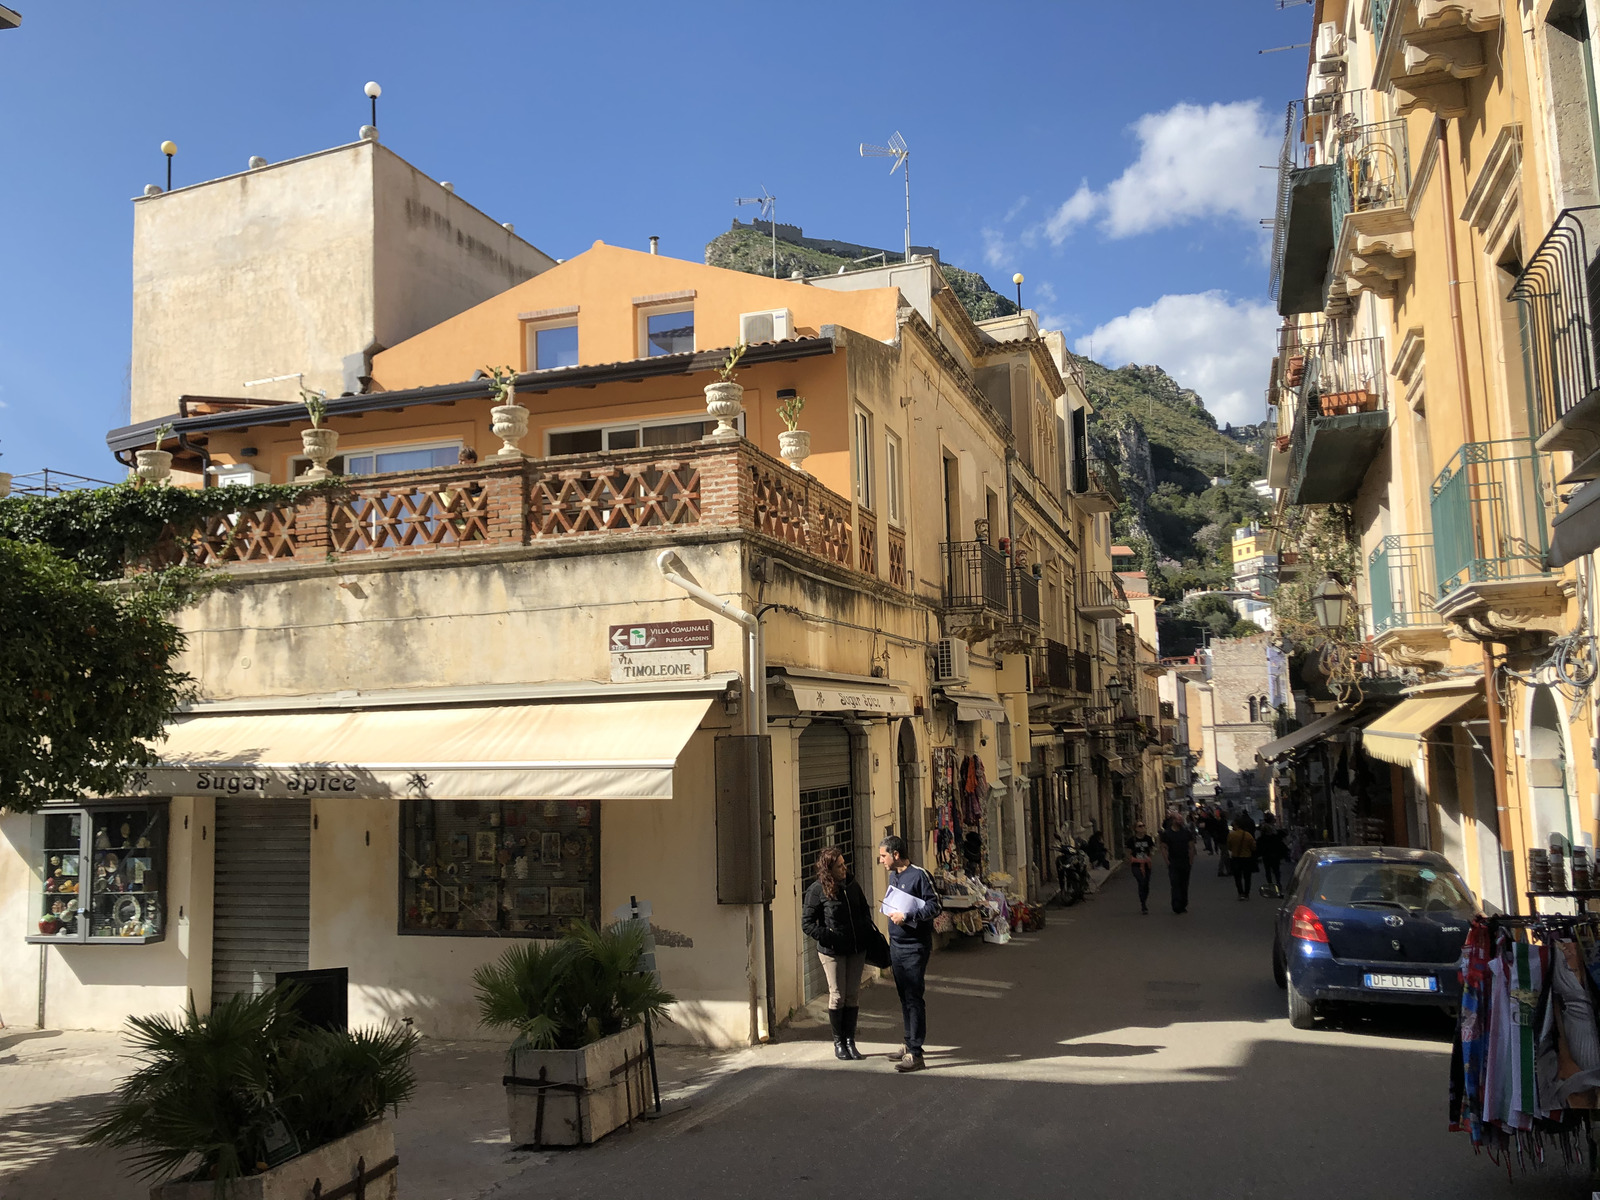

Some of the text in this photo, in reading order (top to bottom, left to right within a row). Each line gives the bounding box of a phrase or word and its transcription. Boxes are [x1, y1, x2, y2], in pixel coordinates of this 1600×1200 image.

[670, 624, 710, 634] COMUNALE
[618, 657, 633, 665] VIA
[624, 664, 692, 678] TIMOLEONE
[838, 692, 861, 709] Sugar
[196, 772, 357, 796] Sugar Spice
